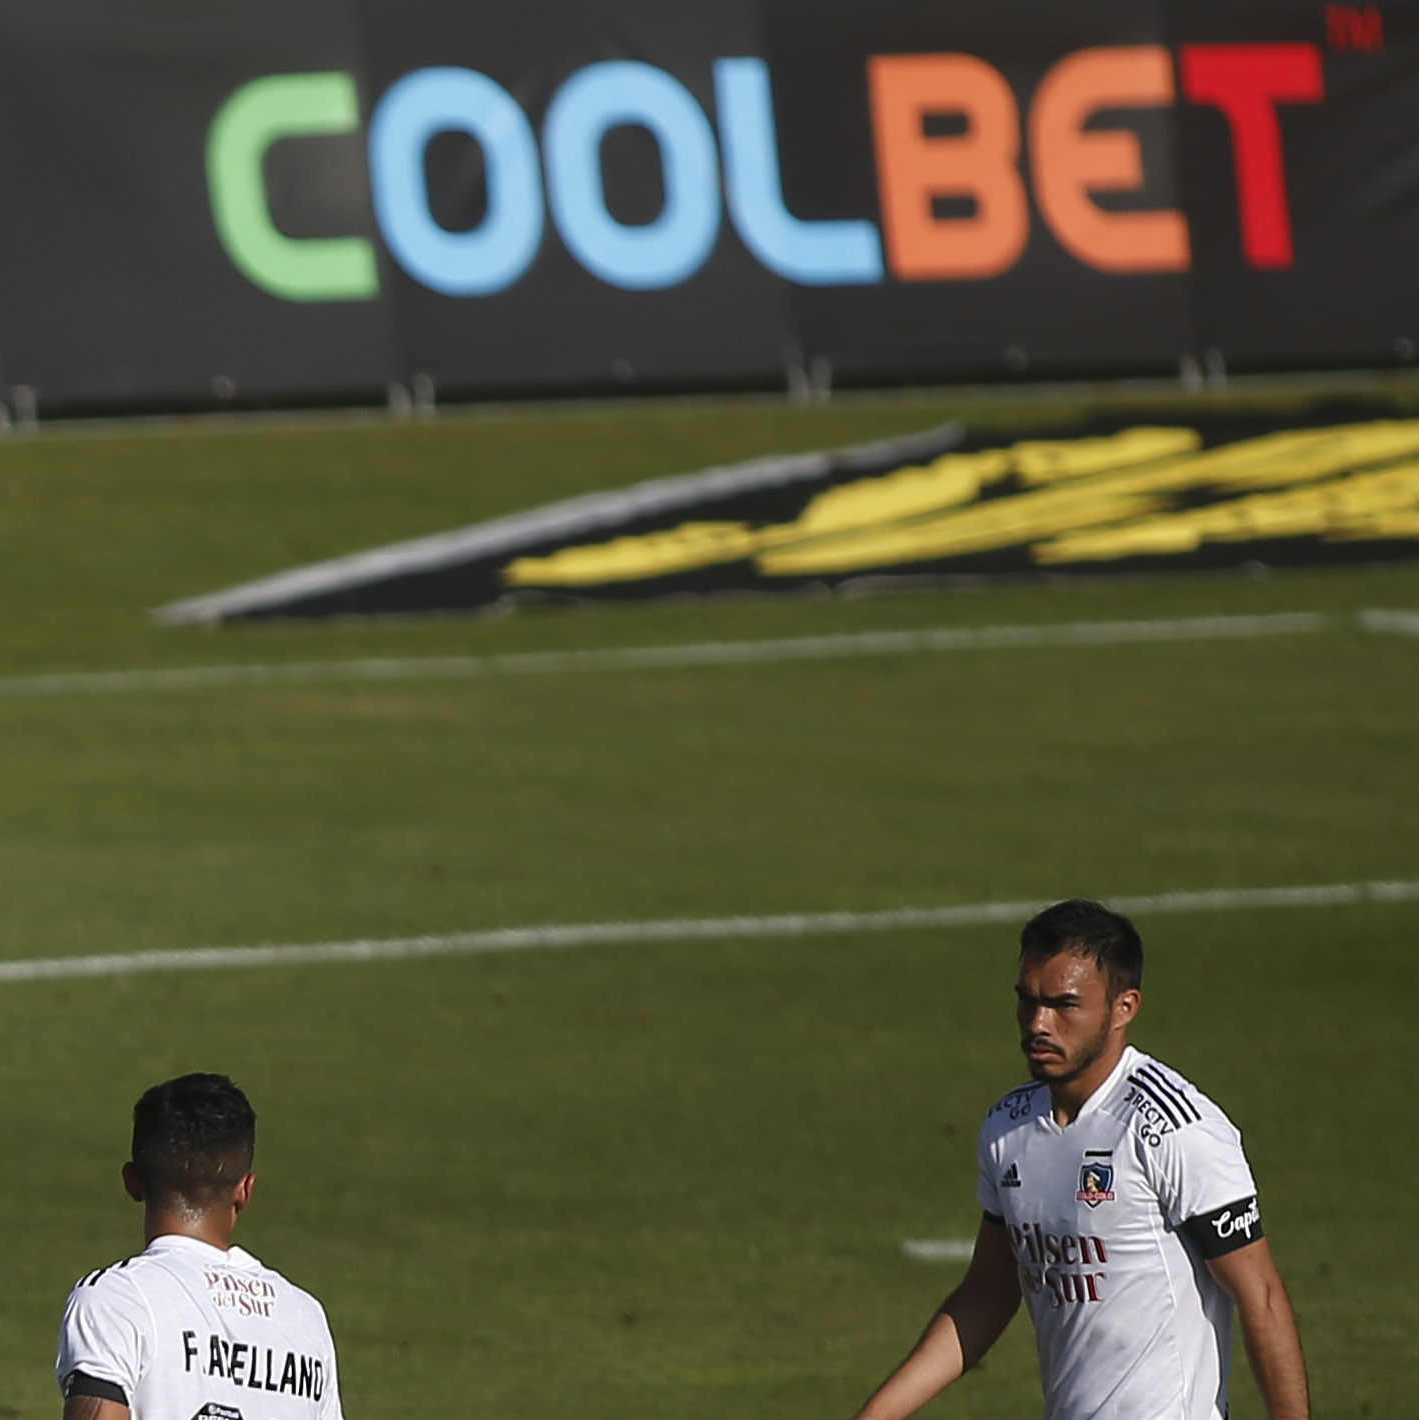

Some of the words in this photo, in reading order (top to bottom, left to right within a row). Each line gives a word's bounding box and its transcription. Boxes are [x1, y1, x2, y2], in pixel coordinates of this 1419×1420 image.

[205, 42, 1323, 304] COOLBET
[1140, 1124, 1161, 1148] GO
[203, 1271, 276, 1298] Pilsen
[212, 1292, 237, 1308] del
[239, 1294, 275, 1318] Sur
